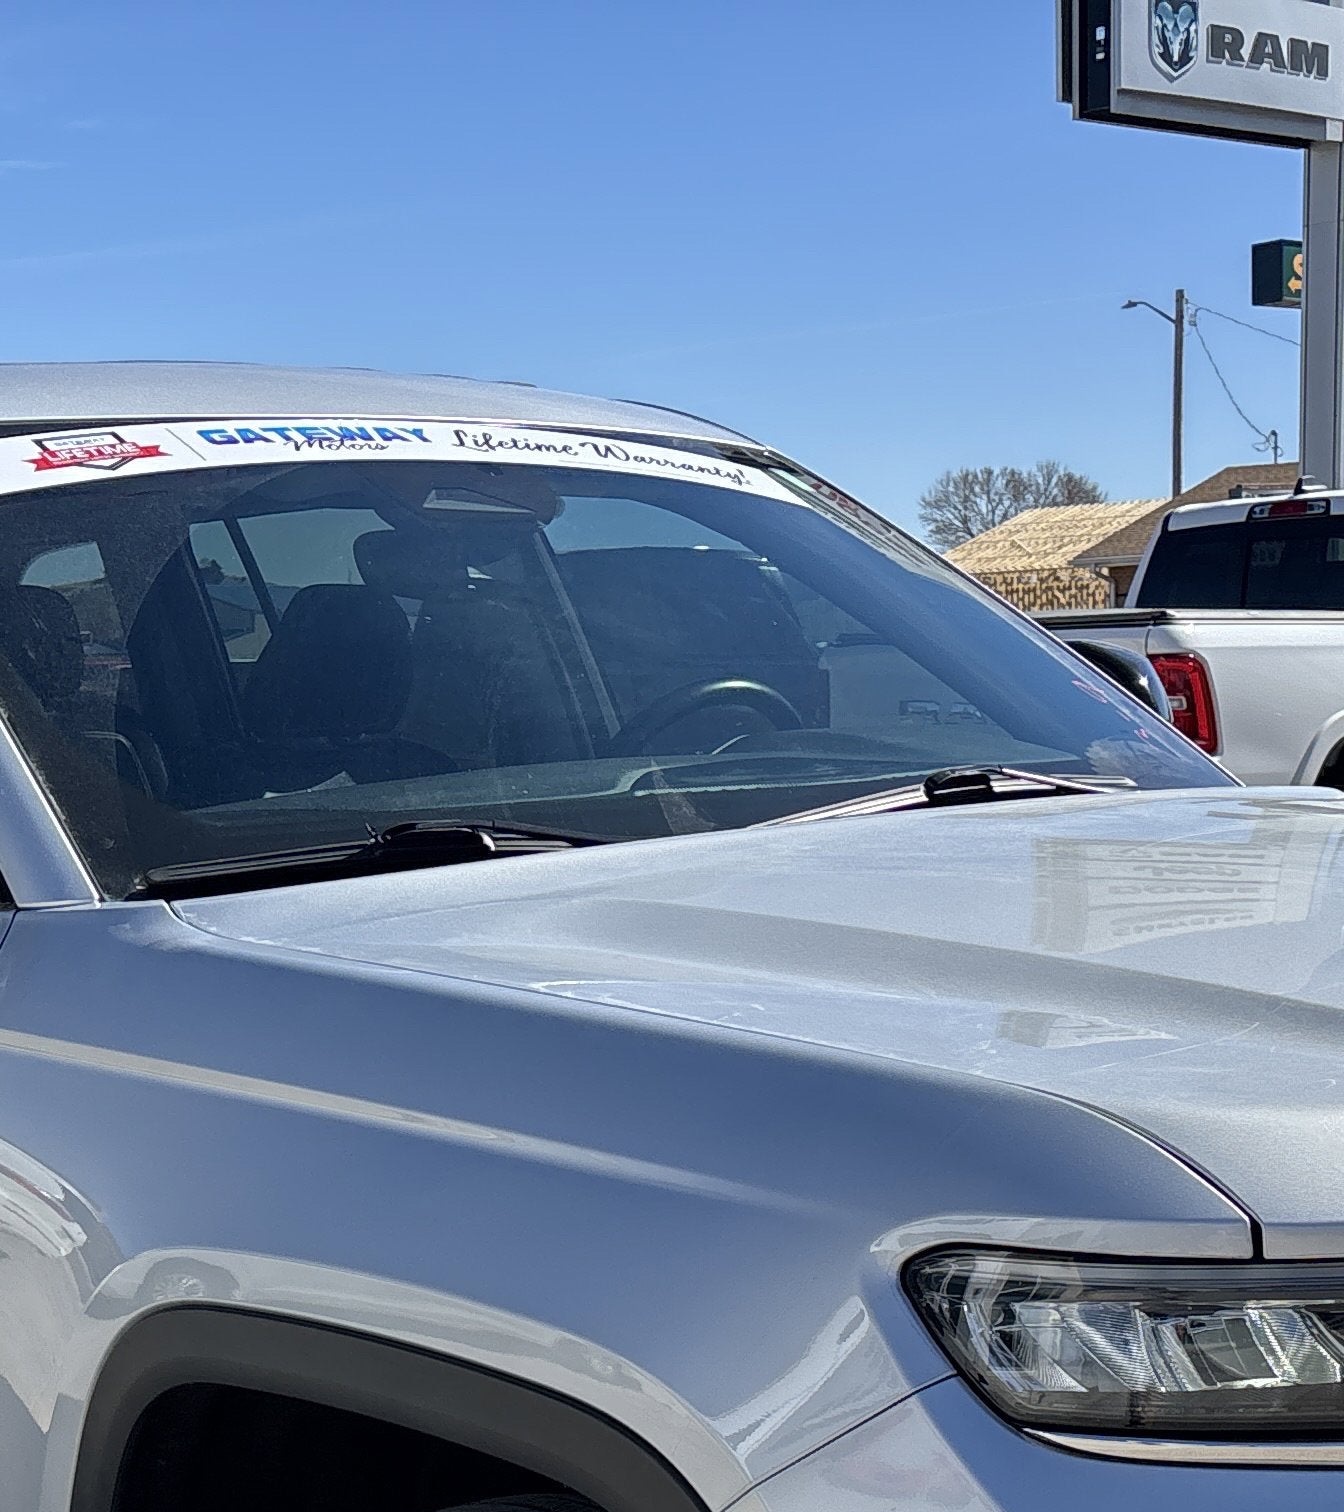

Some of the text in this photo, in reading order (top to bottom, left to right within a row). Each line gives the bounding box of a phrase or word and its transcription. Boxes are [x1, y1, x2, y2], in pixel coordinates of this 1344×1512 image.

[1206, 23, 1330, 80] RAM
[197, 426, 432, 445] GATEWAY
[284, 438, 390, 452] Motors
[43, 441, 140, 463] LIFETIME
[452, 429, 753, 487] Lifetime Warranty!
